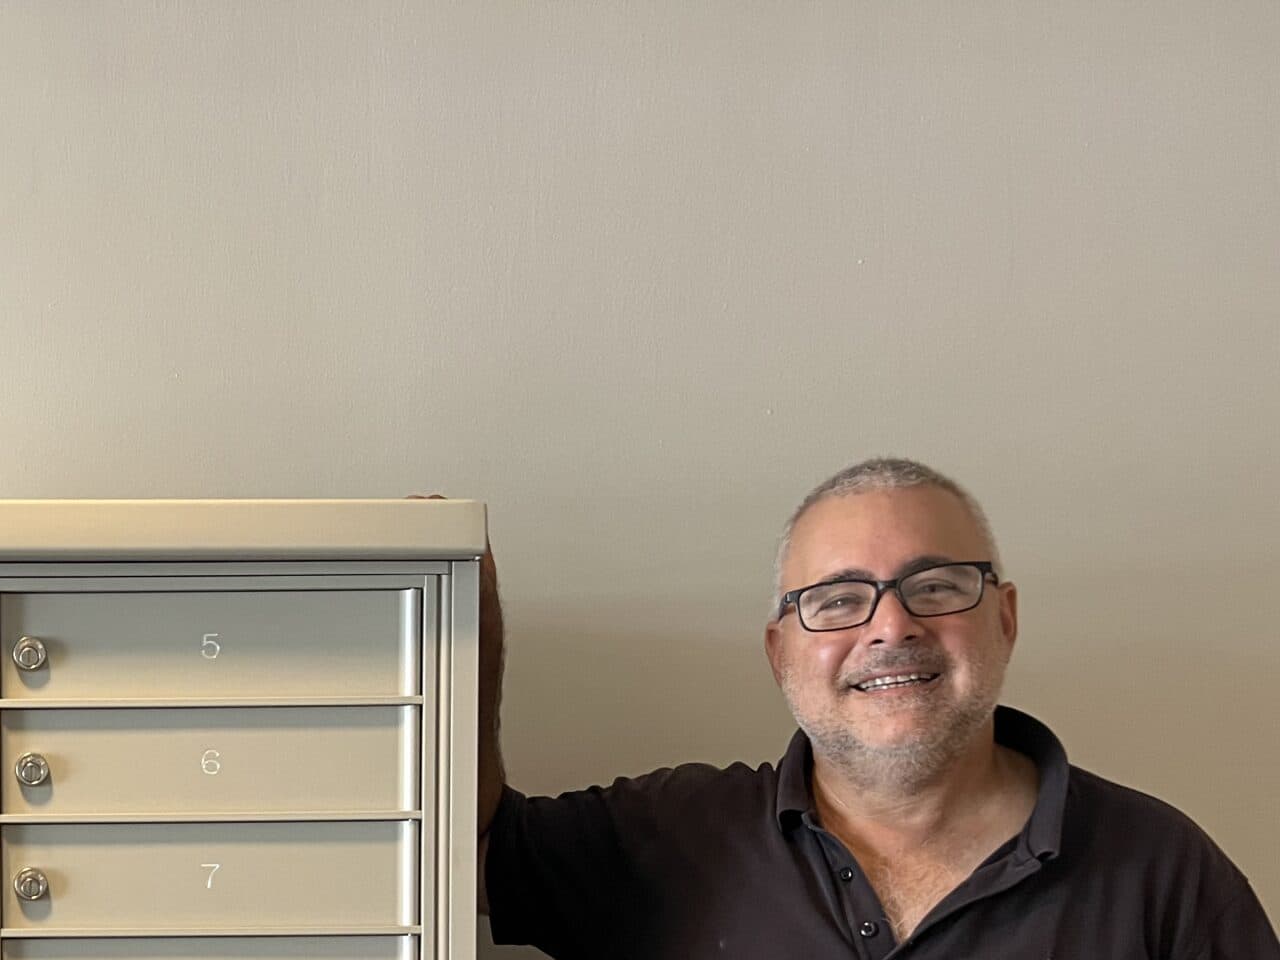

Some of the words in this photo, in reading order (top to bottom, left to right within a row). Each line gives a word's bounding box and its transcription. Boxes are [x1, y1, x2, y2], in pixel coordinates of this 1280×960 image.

[200, 633, 220, 660] 5
[200, 749, 221, 776] 6
[200, 863, 221, 890] 7
